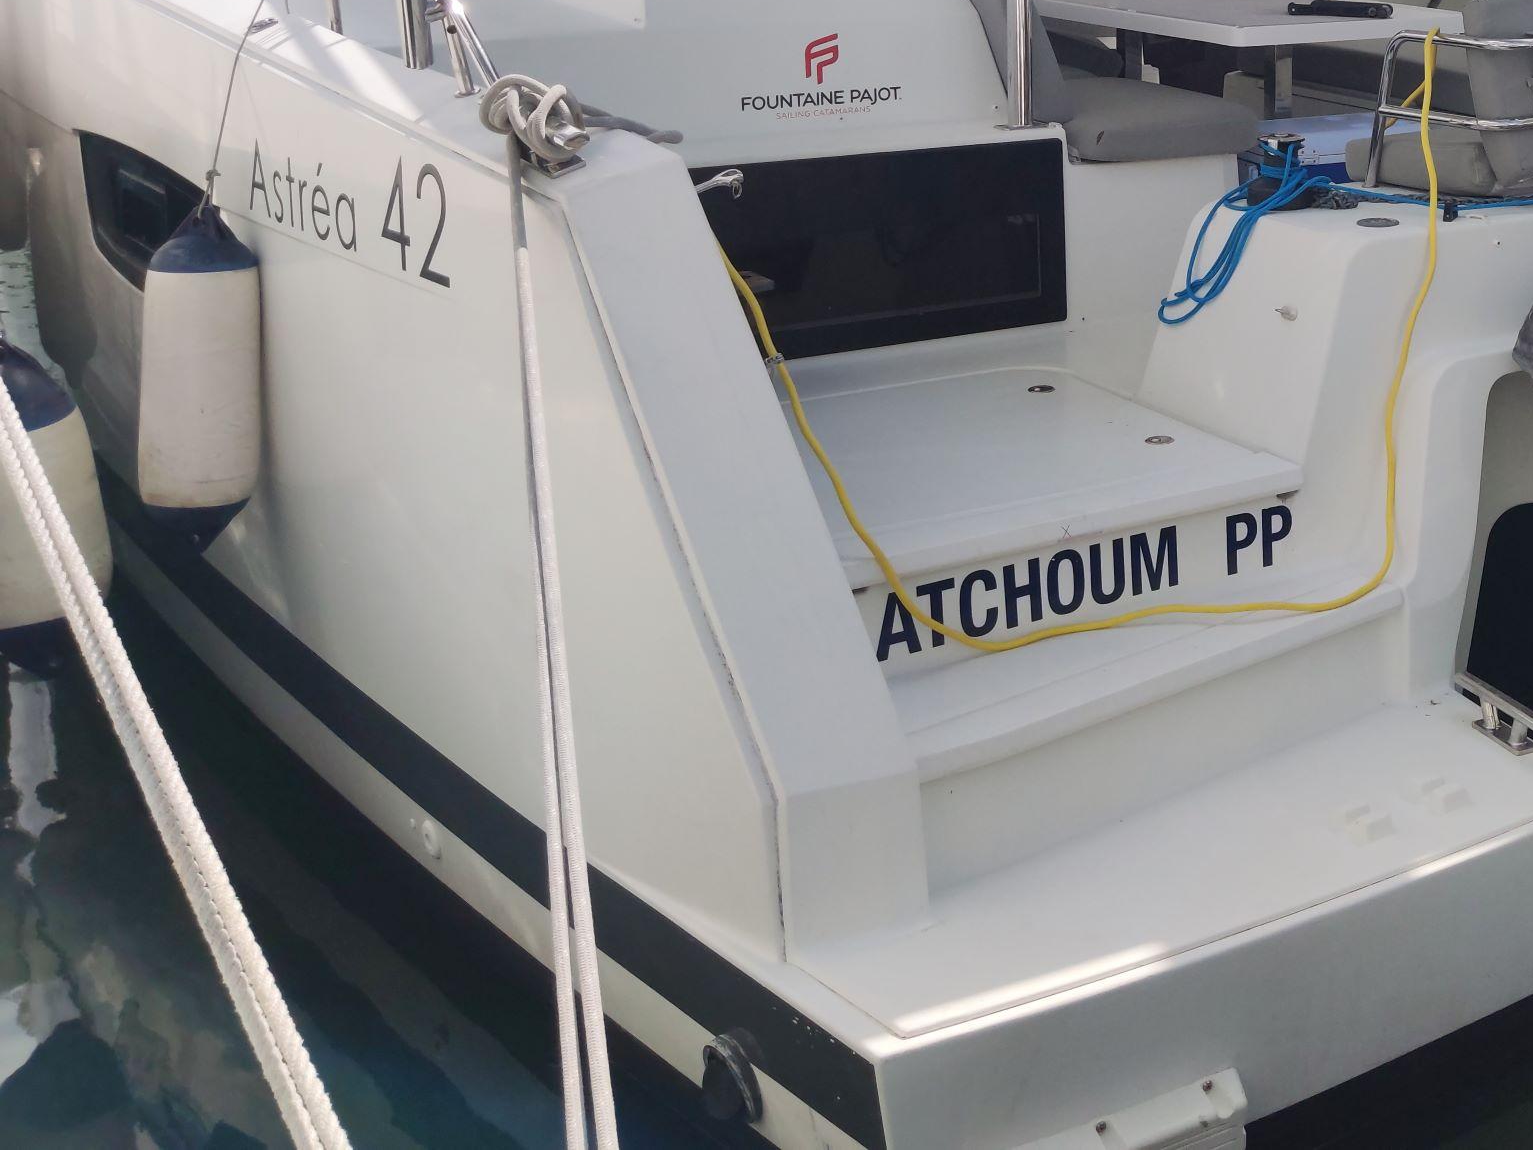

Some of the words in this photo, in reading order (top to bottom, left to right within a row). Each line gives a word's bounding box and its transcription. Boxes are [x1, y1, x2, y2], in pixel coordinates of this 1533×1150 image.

[740, 89, 845, 112] FOUNTAINE
[850, 86, 902, 106] PAJOT
[775, 109, 811, 120] SAILING
[813, 105, 872, 118] CATAMARANS
[249, 137, 358, 253] Astréa
[381, 154, 451, 289] 42
[876, 524, 1180, 663] ATCHOUM
[1225, 503, 1294, 576] PP
